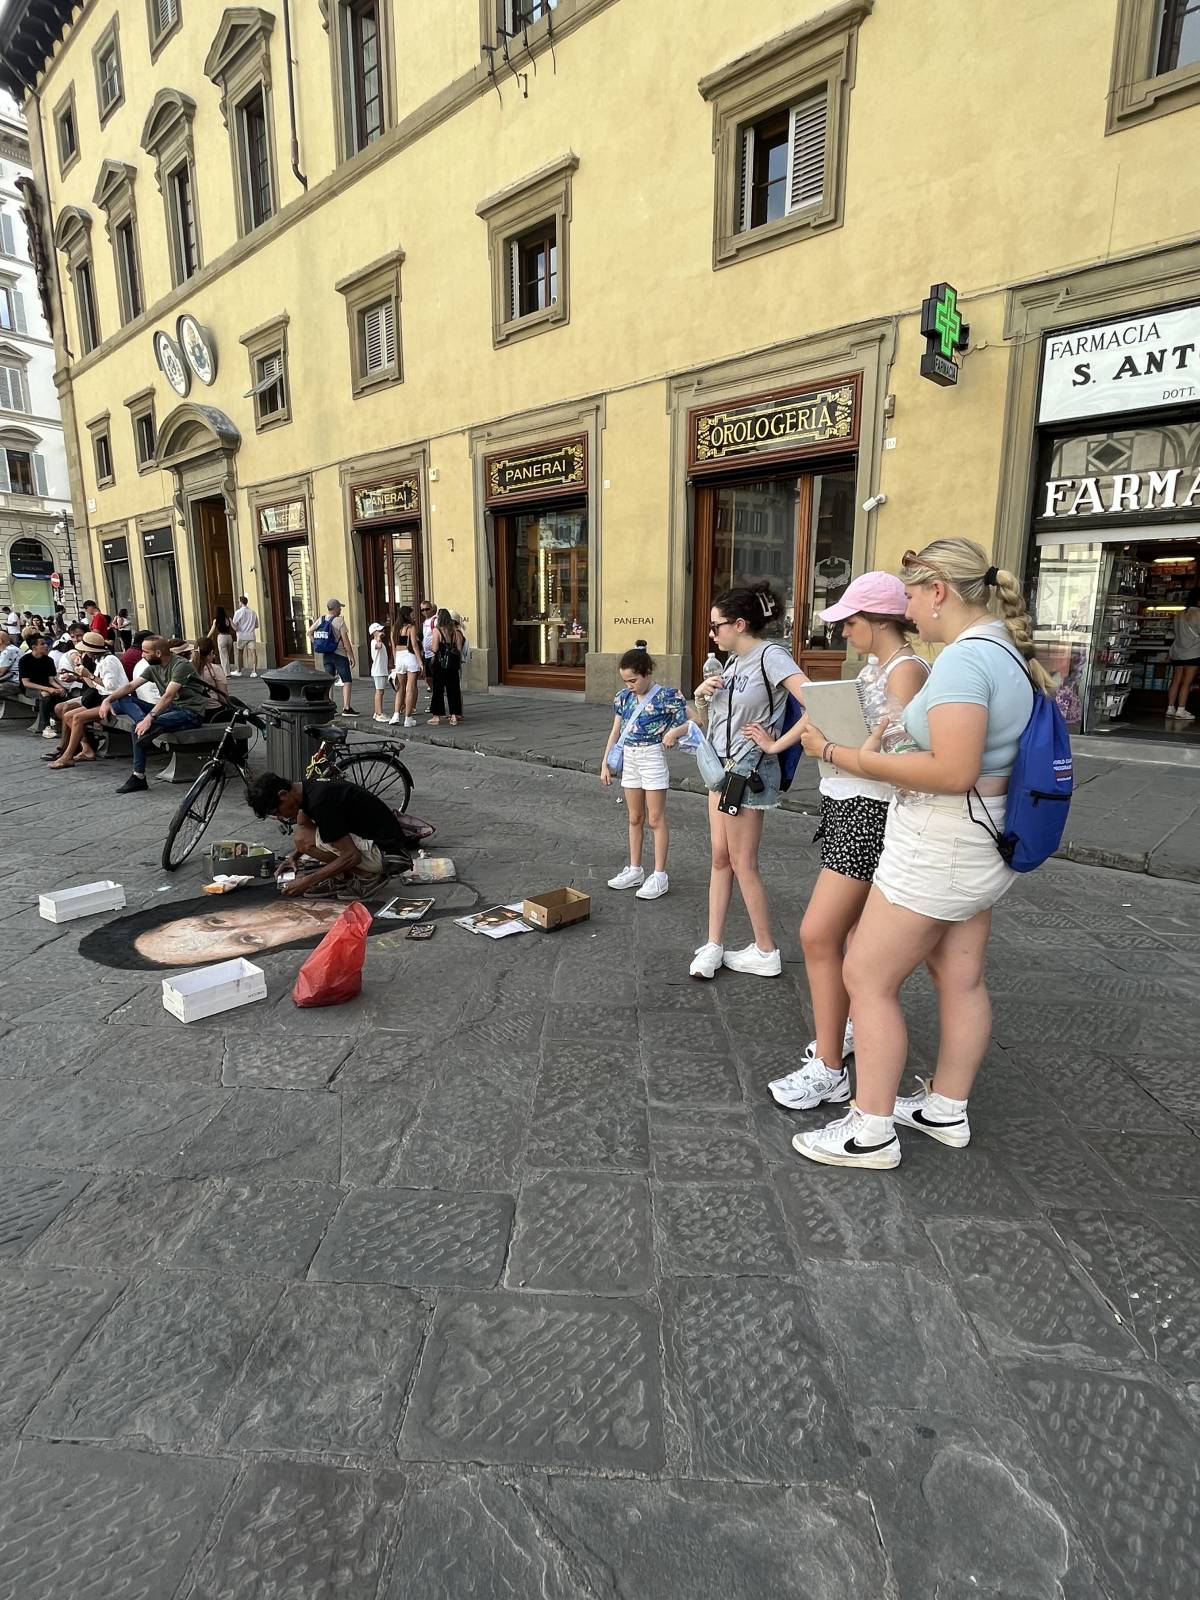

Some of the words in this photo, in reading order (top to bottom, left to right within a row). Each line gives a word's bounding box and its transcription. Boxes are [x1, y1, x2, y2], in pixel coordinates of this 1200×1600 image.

[1049, 321, 1162, 361] FARMACIA
[1072, 362, 1097, 387] S.
[1112, 343, 1200, 380] ANT
[1162, 386, 1196, 400] DOTT.
[710, 404, 834, 447] OROLOGERIA
[505, 459, 566, 482] PANERAI
[366, 490, 407, 507] PANERAI
[613, 617, 654, 625] PANERAI
